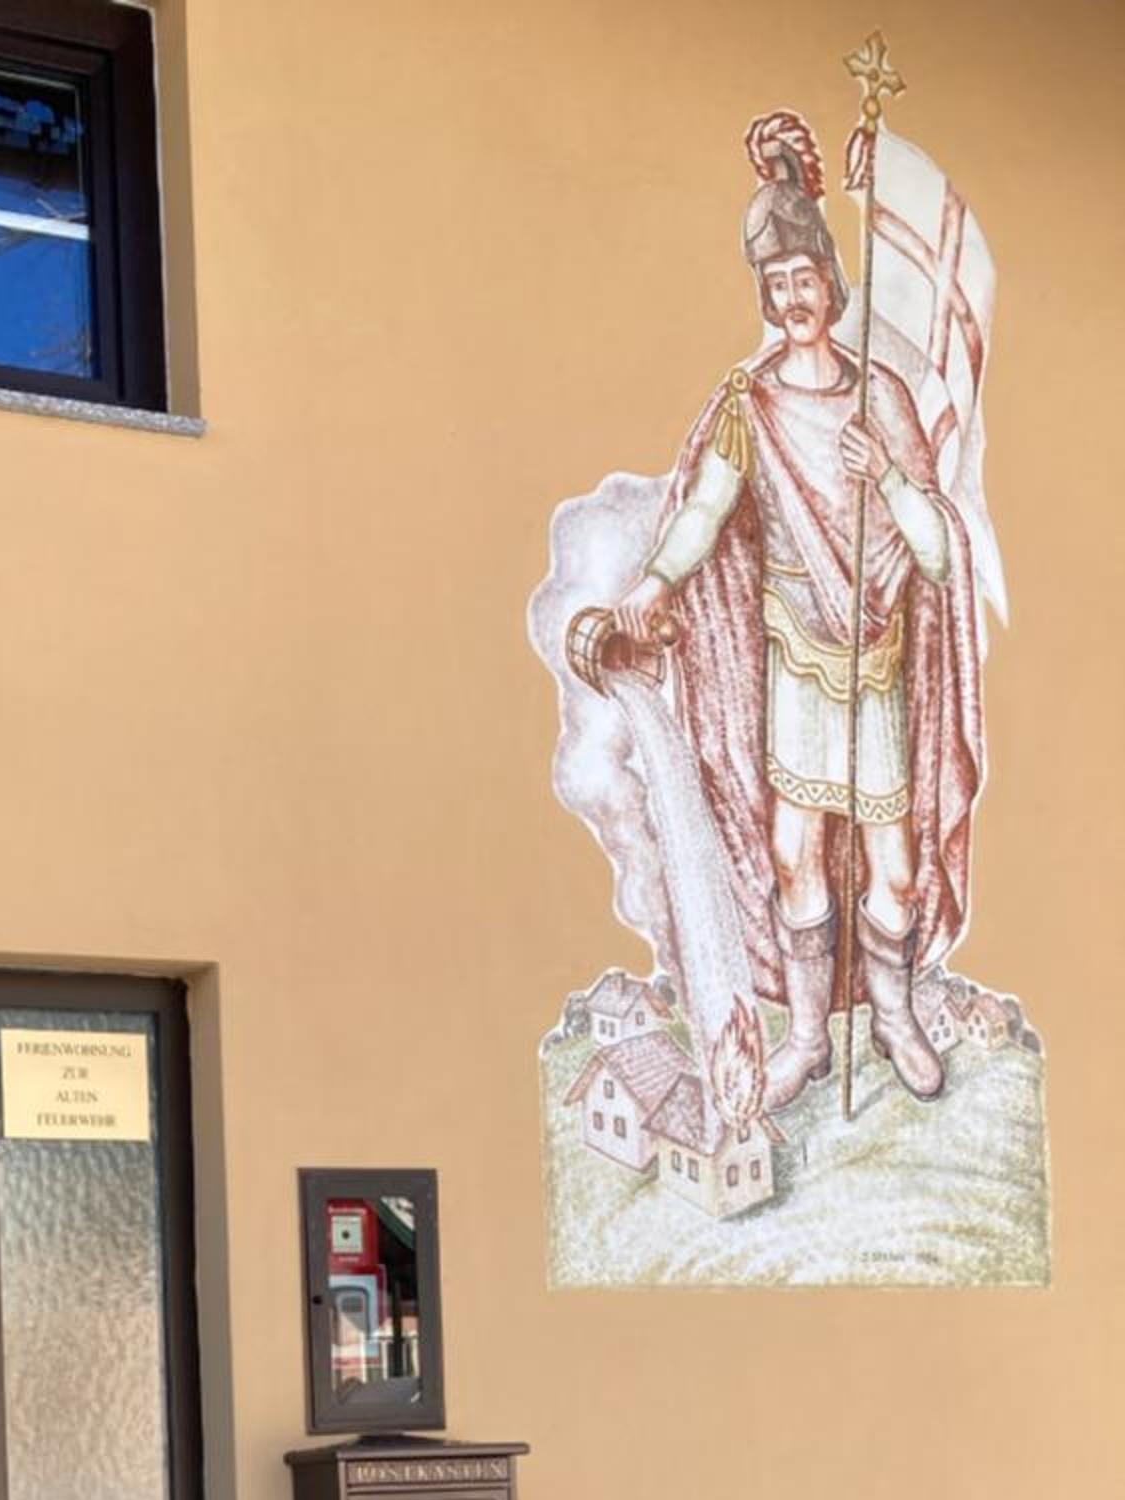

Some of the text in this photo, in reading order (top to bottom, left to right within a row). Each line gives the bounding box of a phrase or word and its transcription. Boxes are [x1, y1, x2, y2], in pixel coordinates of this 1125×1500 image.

[16, 1041, 132, 1058] FERIENWOHNUNG
[61, 1066, 89, 1080] ZUR
[55, 1089, 99, 1103] ALTEN
[36, 1112, 117, 1126] FEUERWEHR
